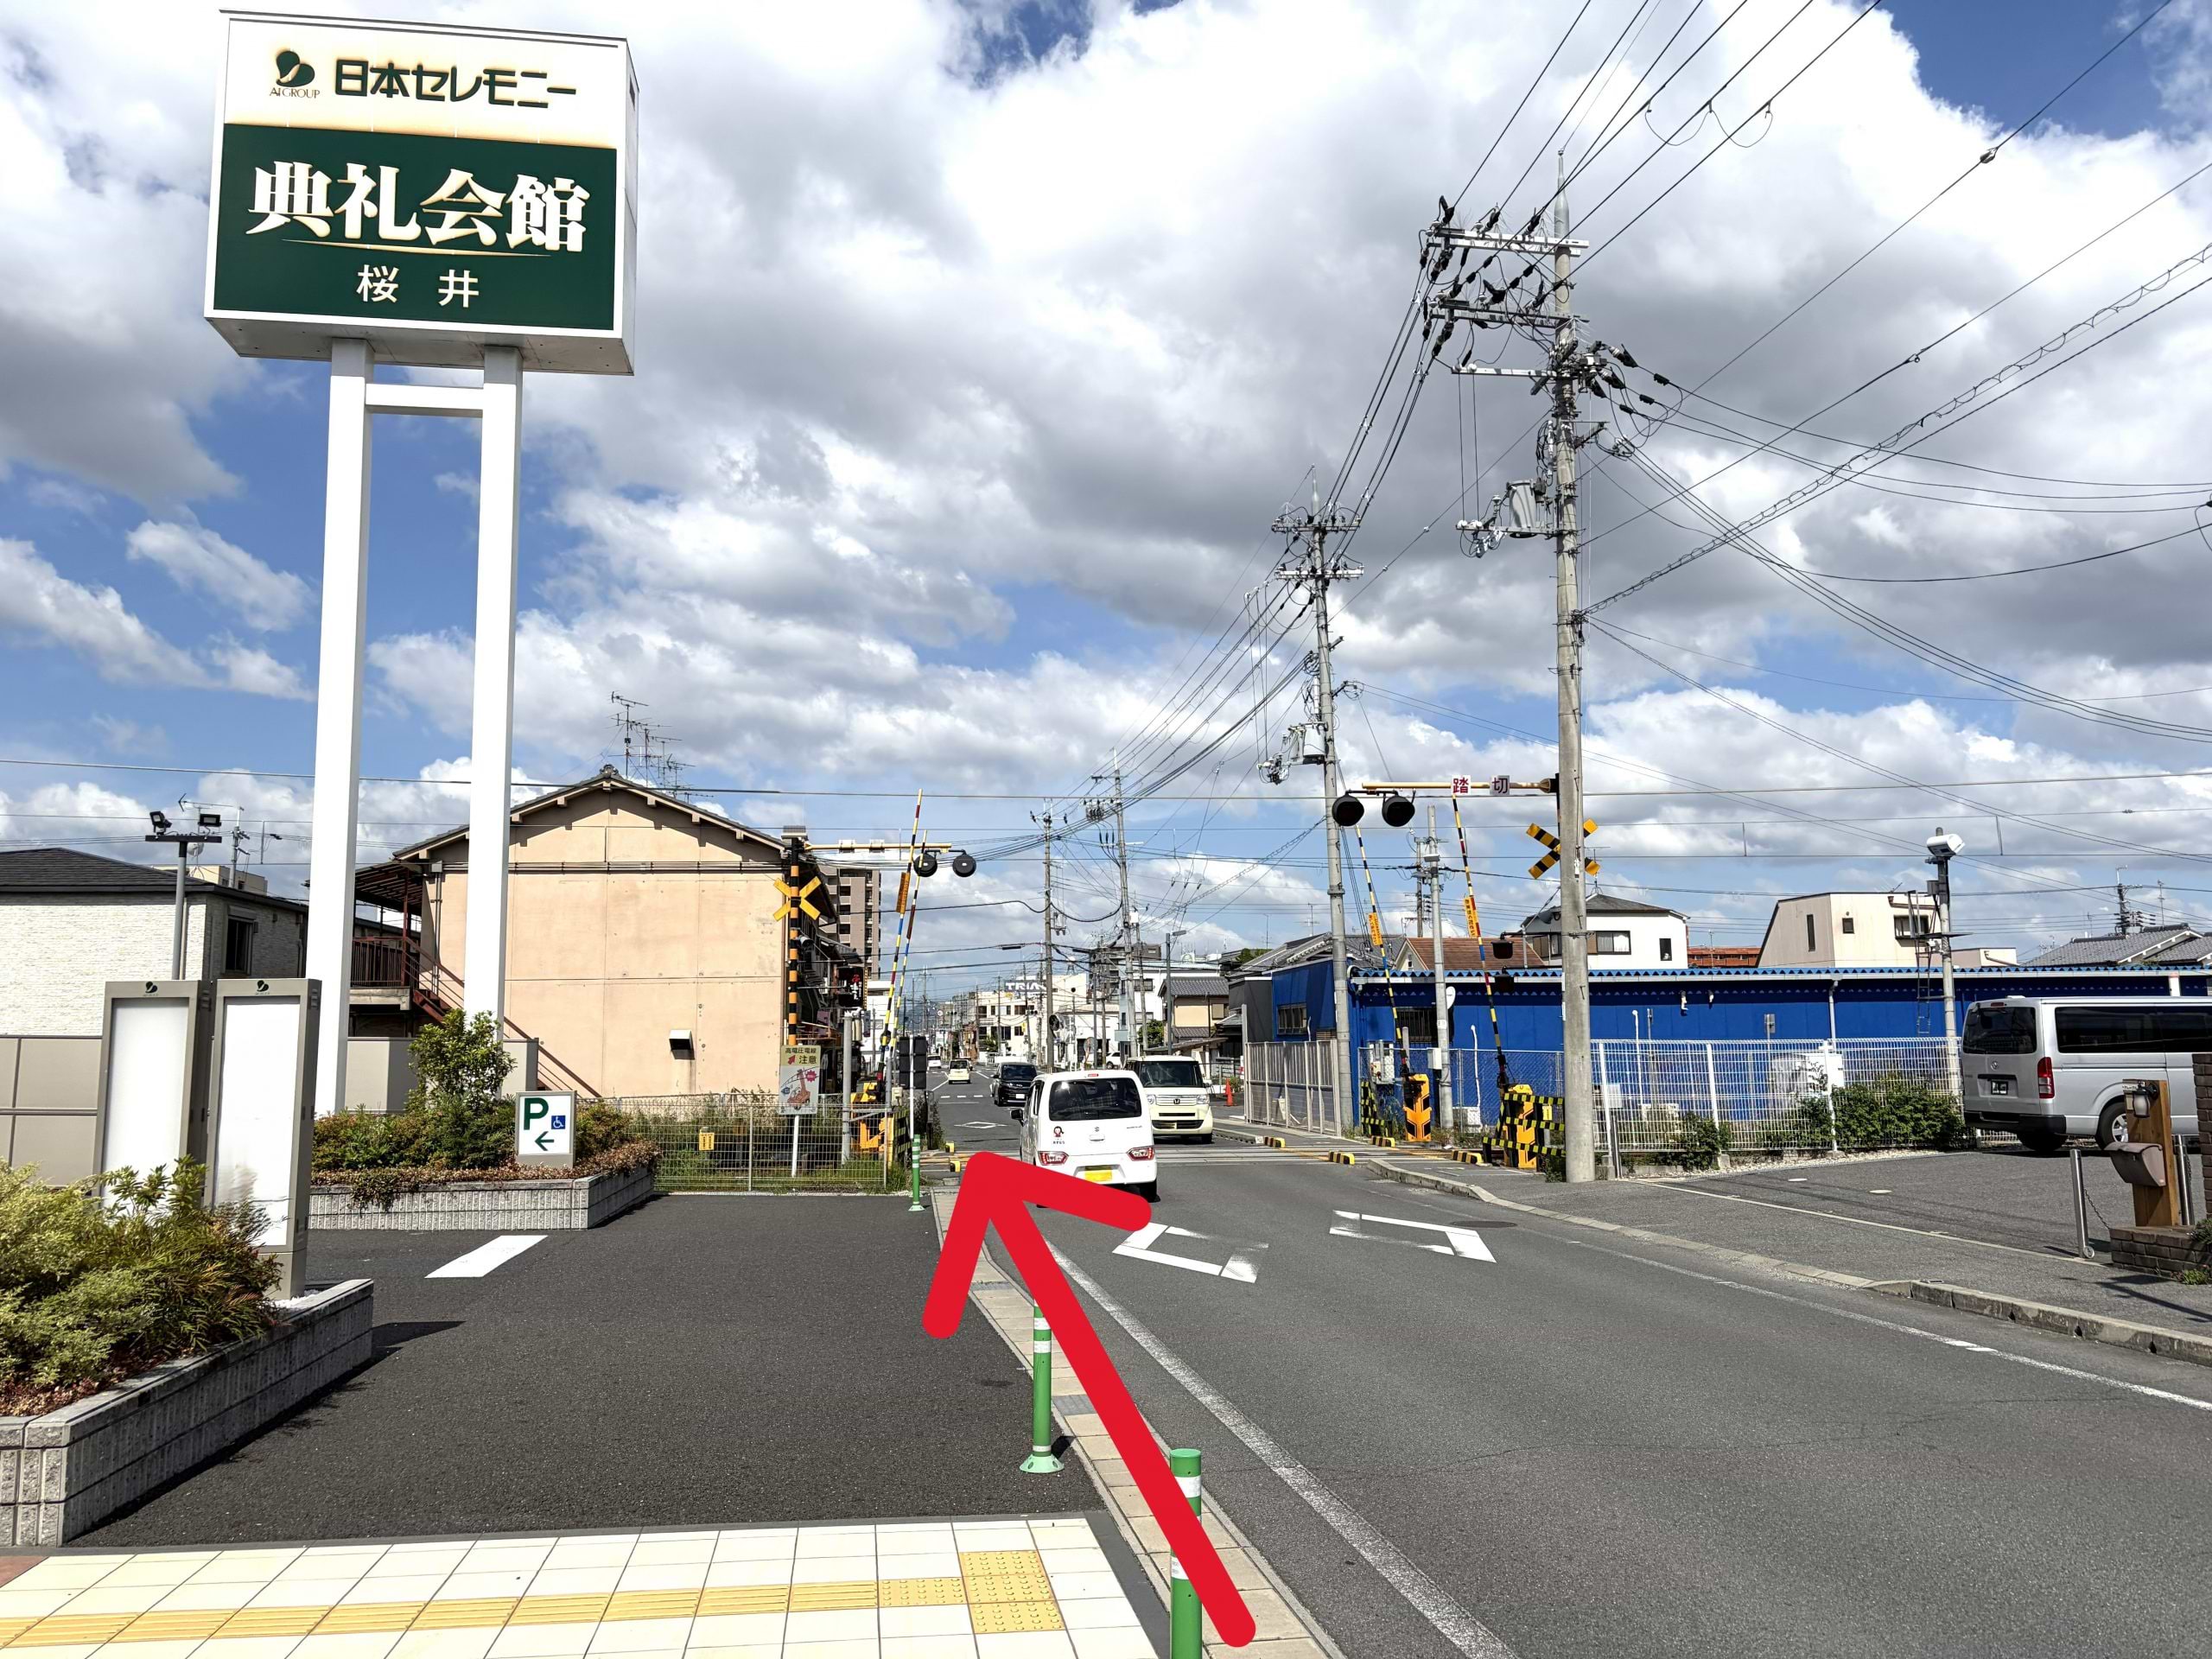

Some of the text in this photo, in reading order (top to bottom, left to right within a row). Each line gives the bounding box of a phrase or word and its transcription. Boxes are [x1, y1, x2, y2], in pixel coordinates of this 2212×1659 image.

[269, 87, 321, 99] AI GROUP
[334, 59, 577, 109] 日本セレモニー
[245, 161, 591, 252] 典礼会館
[798, 1055, 817, 1065] 注意
[524, 1097, 550, 1130] P
